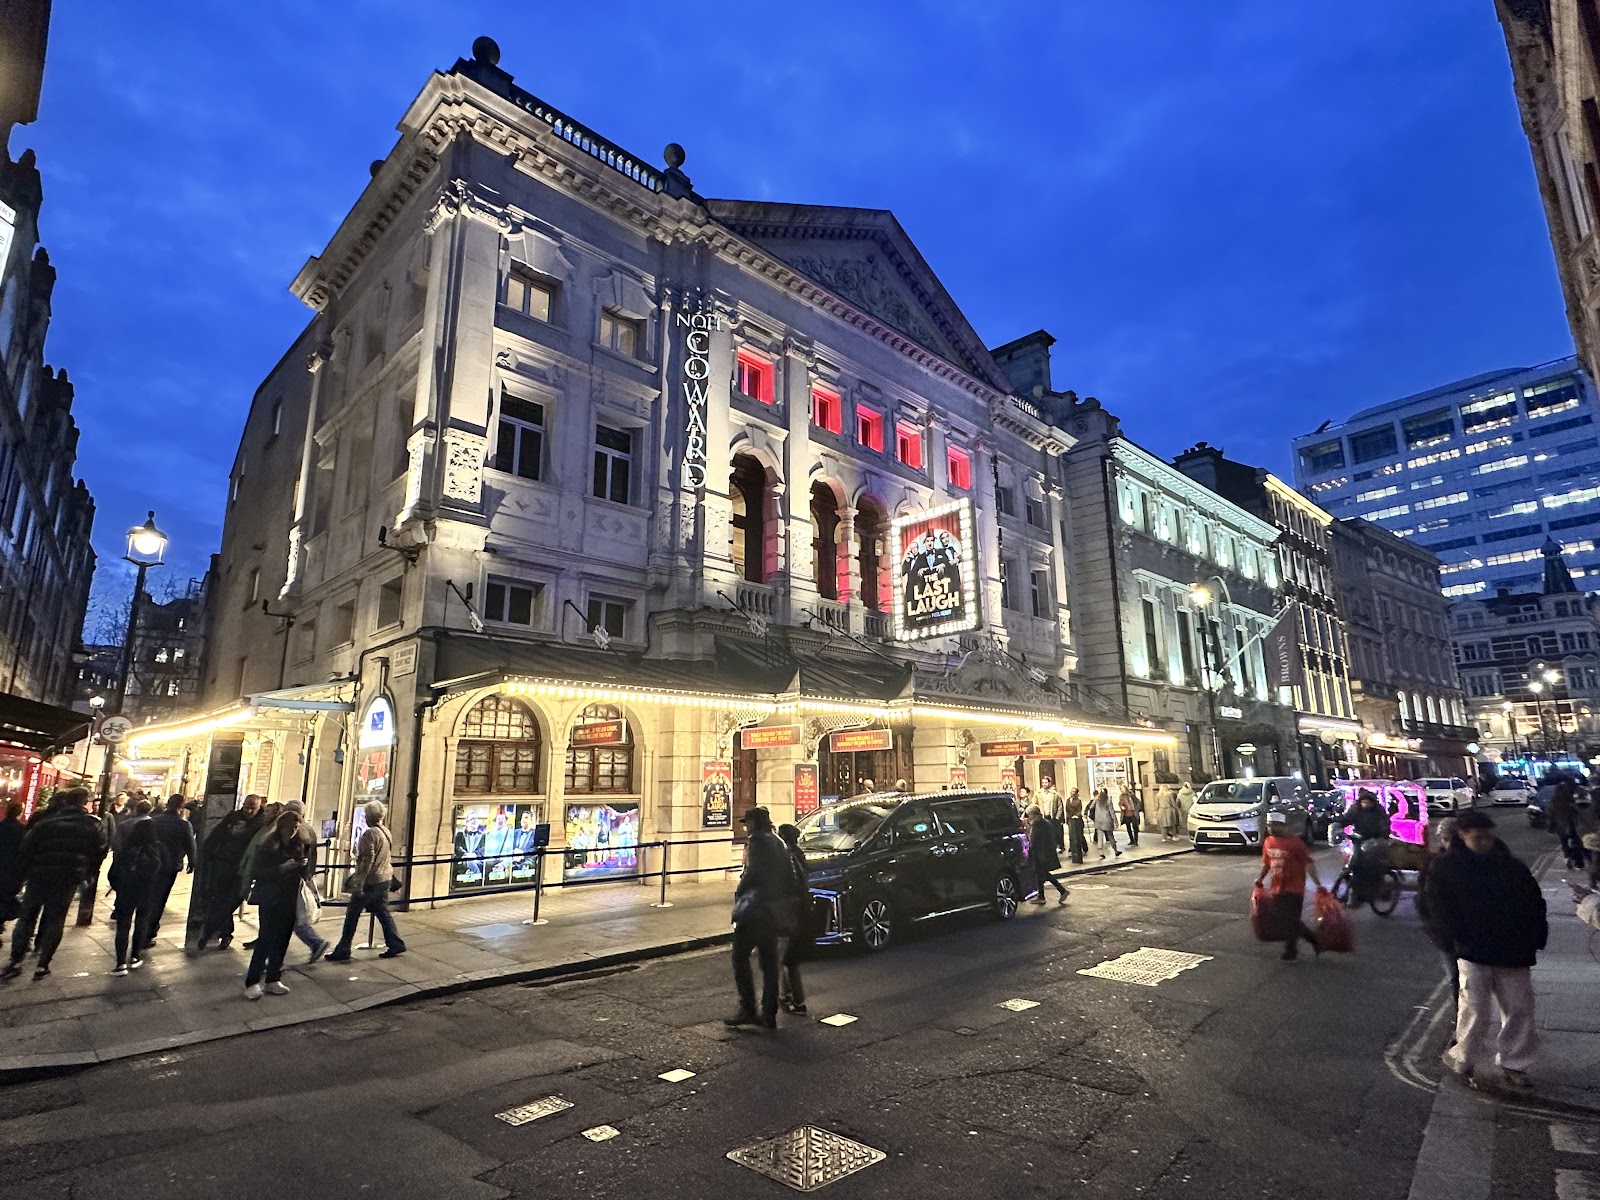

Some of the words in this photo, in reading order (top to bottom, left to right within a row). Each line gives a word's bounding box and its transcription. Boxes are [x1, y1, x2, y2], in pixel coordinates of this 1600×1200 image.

[683, 331, 711, 488] COWARD
[914, 577, 951, 600] LAST
[924, 573, 939, 583] THE
[907, 591, 960, 616] LAUGH
[1277, 635, 1290, 682] BROWNS
